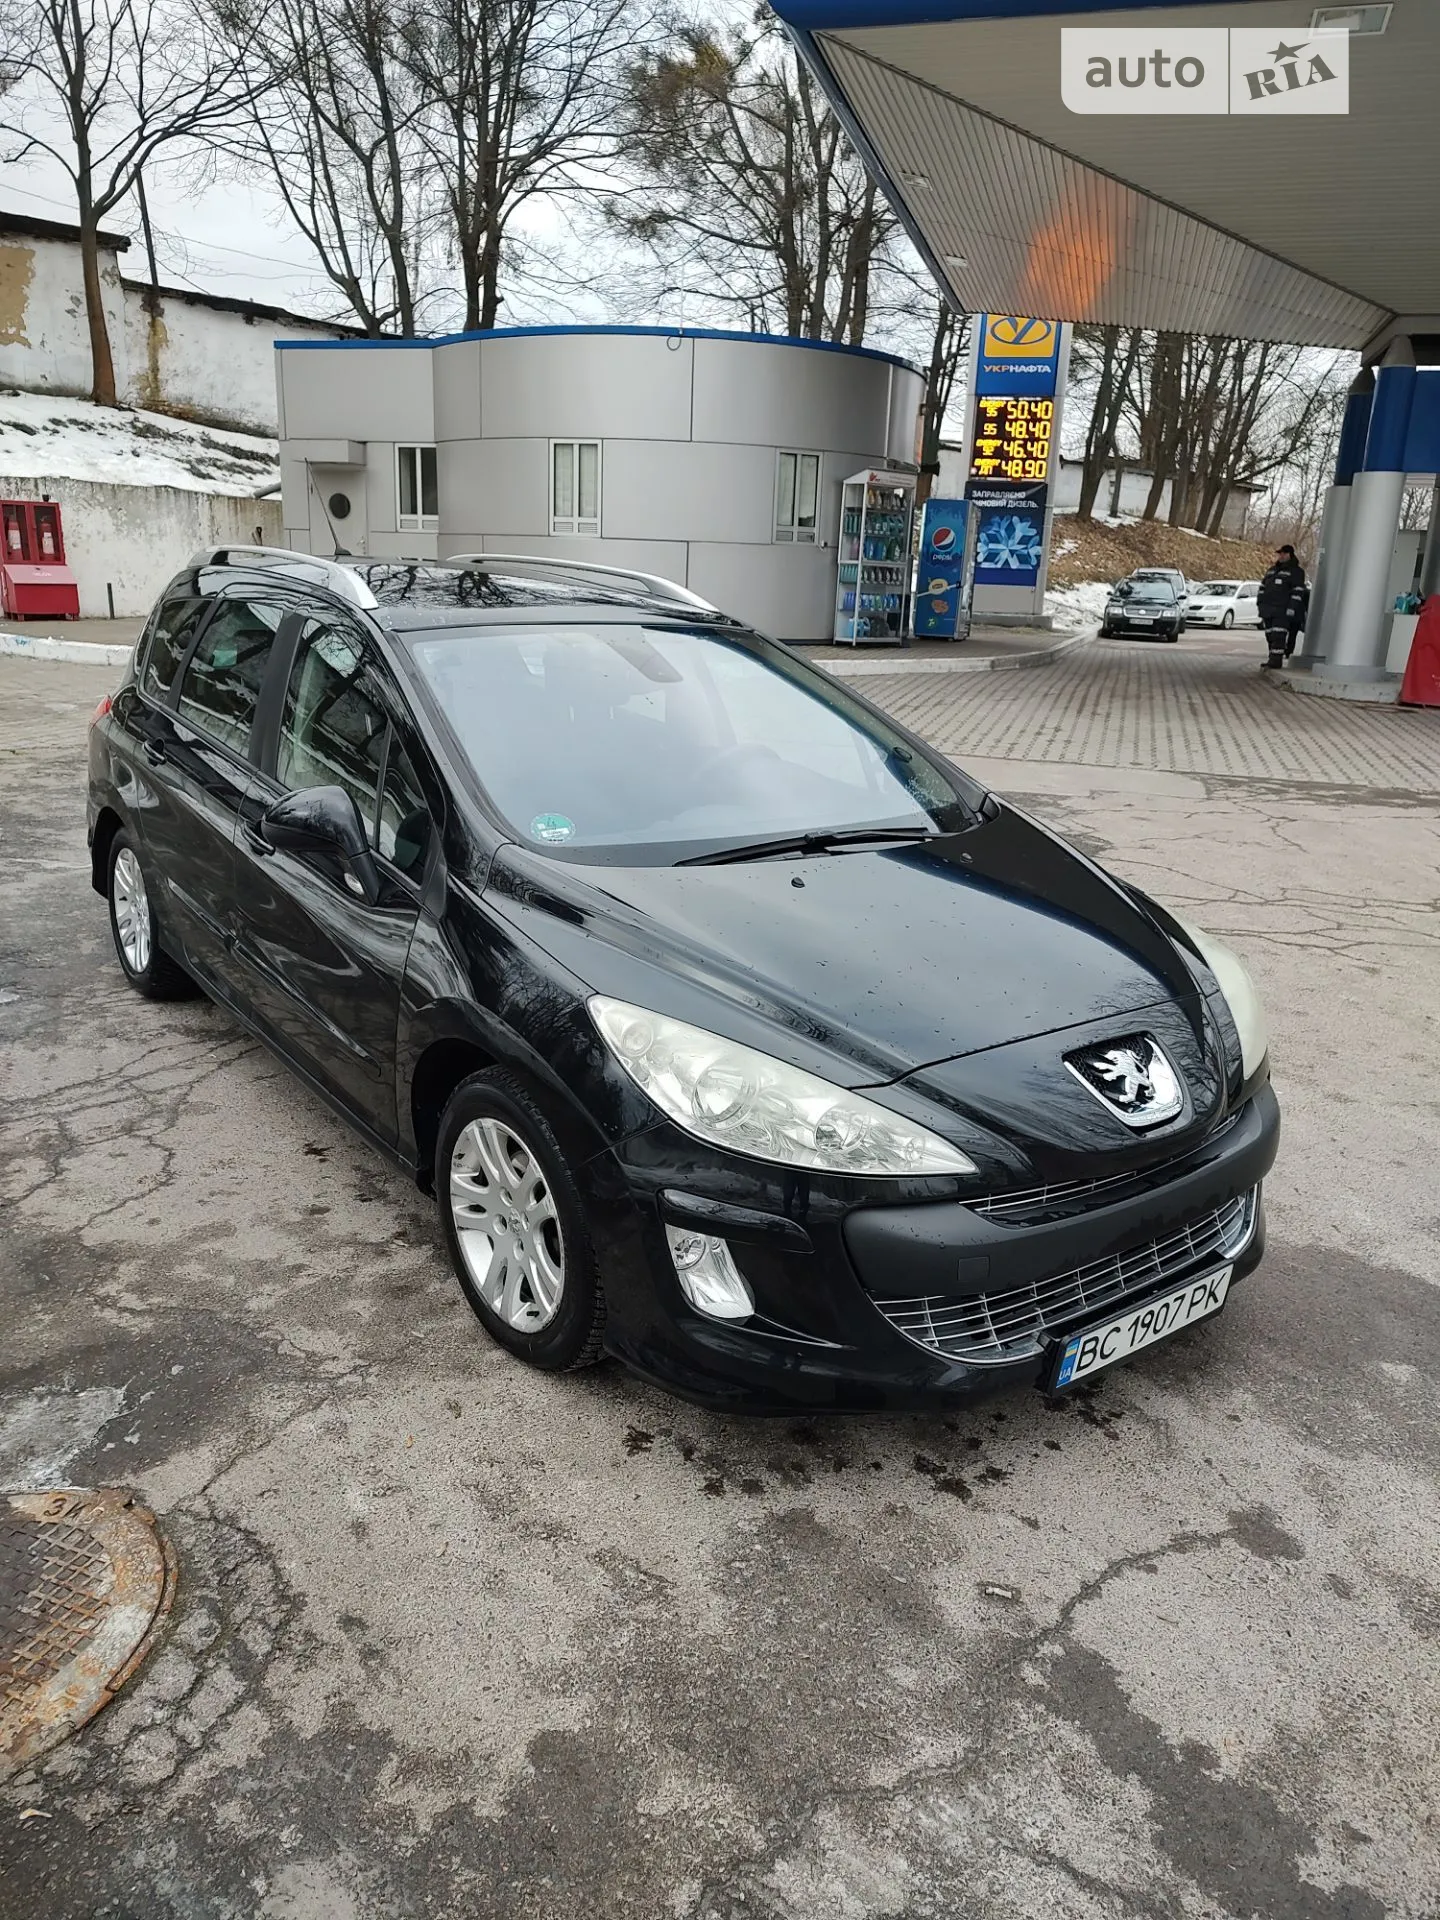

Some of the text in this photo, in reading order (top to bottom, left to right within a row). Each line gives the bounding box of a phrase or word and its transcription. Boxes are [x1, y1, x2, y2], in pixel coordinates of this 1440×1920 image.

[984, 365, 1051, 373] УКРНАФТА
[1007, 400, 1053, 419] 50.40
[983, 420, 1050, 439] 95 48.40
[1003, 440, 1049, 458] 46.40
[1001, 459, 1047, 478] 48.90
[1075, 1271, 1227, 1373] BC 1907 PK
[1059, 1367, 1072, 1381] UA
